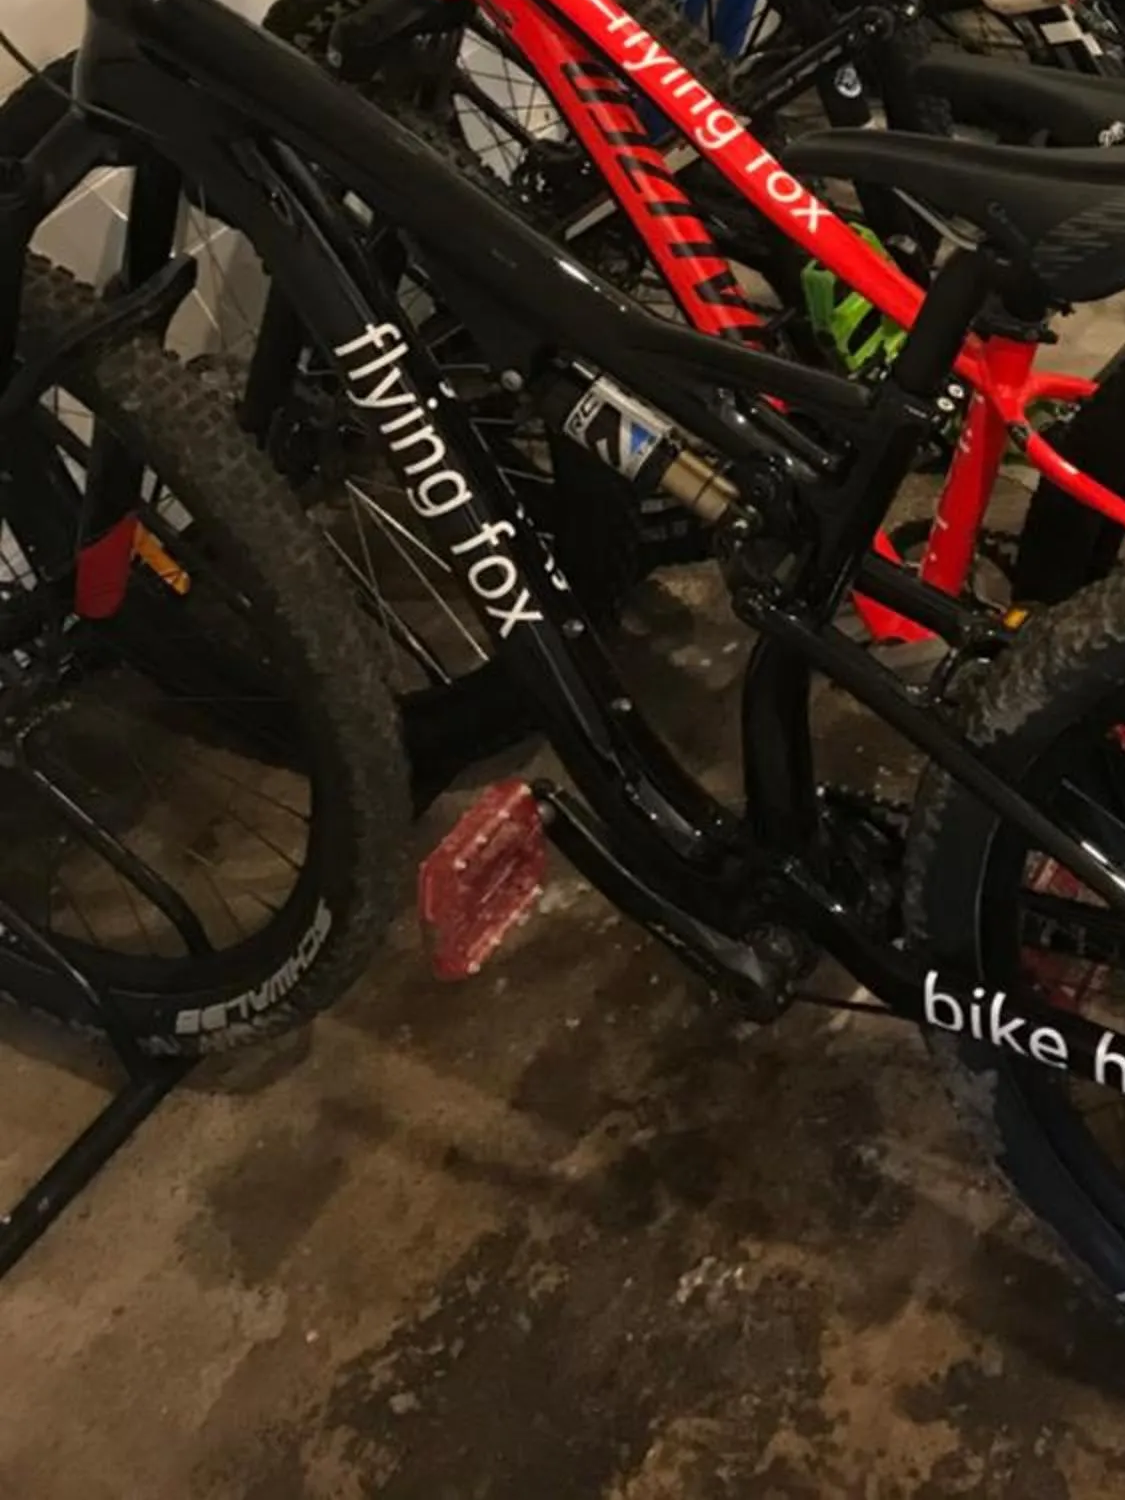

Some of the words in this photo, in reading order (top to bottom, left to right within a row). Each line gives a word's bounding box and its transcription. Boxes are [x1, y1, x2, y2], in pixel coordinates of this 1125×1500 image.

[607, 12, 744, 148] flying
[745, 150, 832, 233] fox
[335, 322, 473, 518] flying
[451, 520, 544, 639] fox
[924, 970, 1069, 1070] bike
